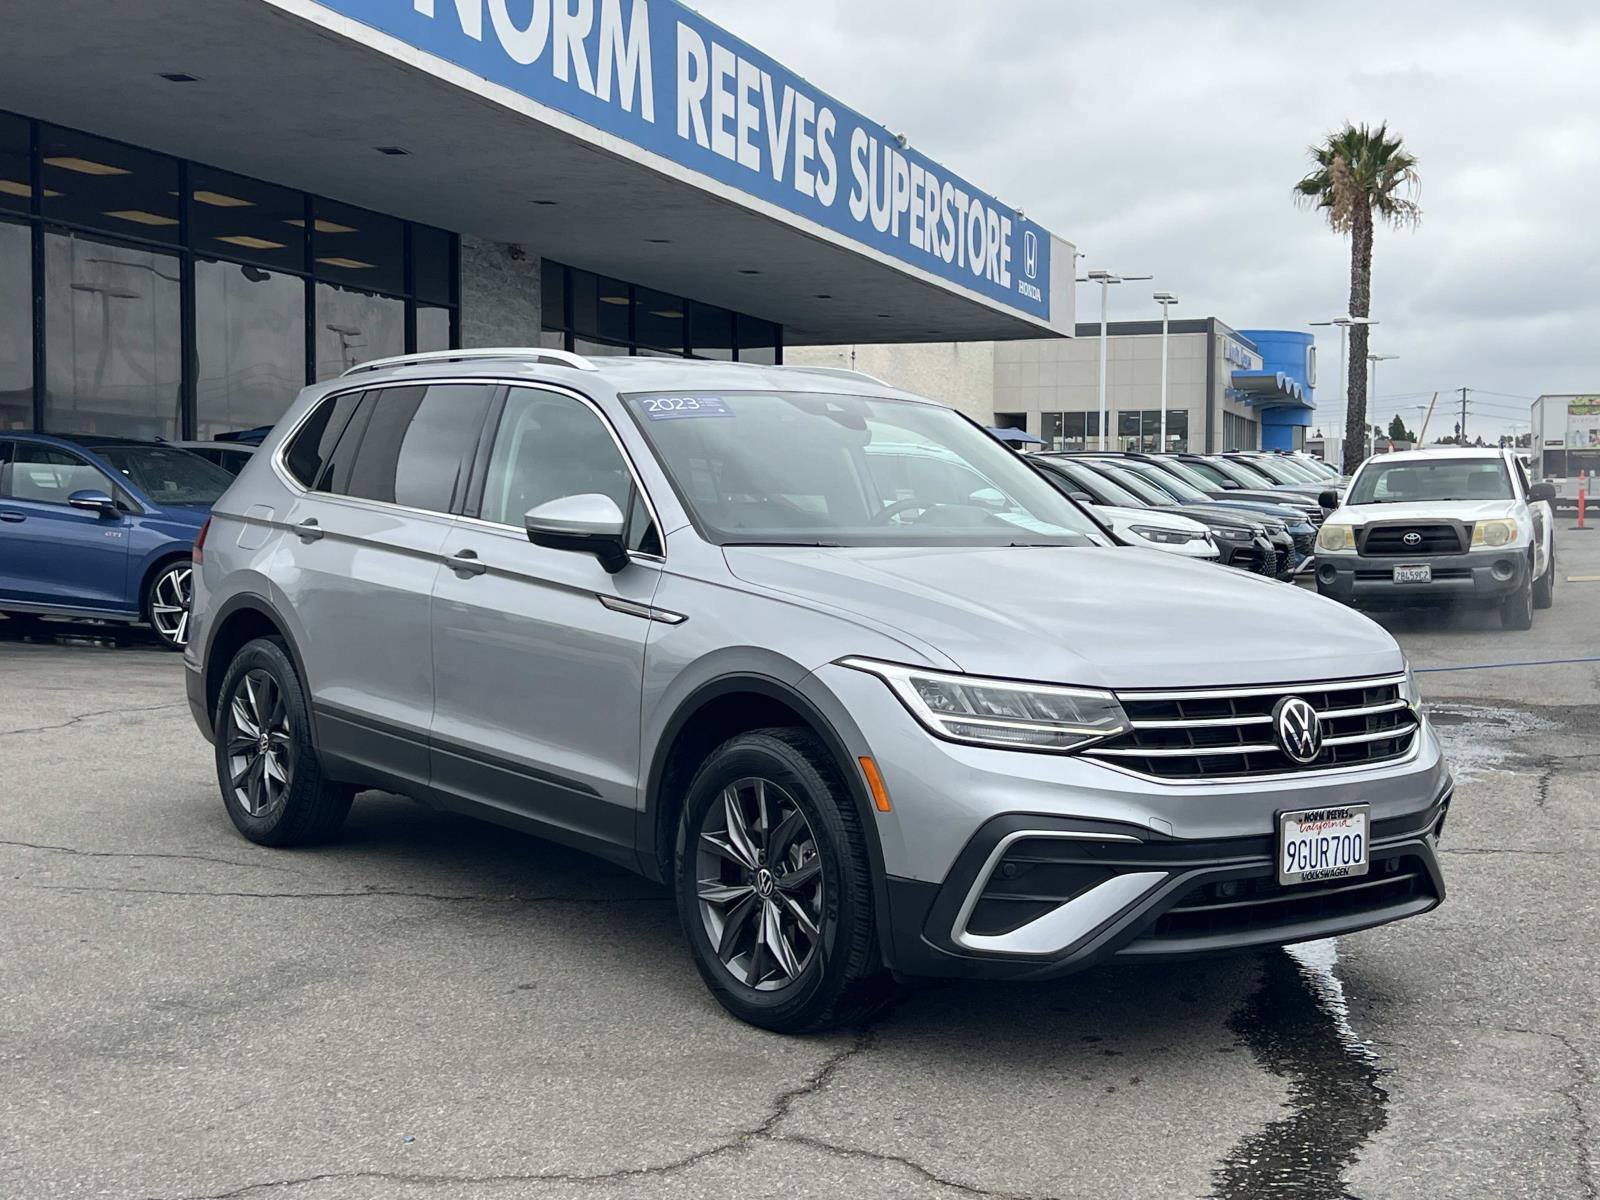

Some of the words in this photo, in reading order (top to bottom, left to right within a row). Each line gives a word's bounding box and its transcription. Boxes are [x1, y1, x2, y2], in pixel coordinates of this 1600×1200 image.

[413, 0, 655, 124] RM
[677, 20, 838, 207] REEVES
[849, 127, 1012, 289] SUPERSTORE
[1018, 279, 1042, 302] HONDA
[643, 398, 700, 412] 2023
[1304, 811, 1325, 822] NORM
[1326, 808, 1350, 819] REEVES
[1286, 833, 1362, 873] 9GUR700
[1302, 867, 1350, 881] VOLKSWAGEN
